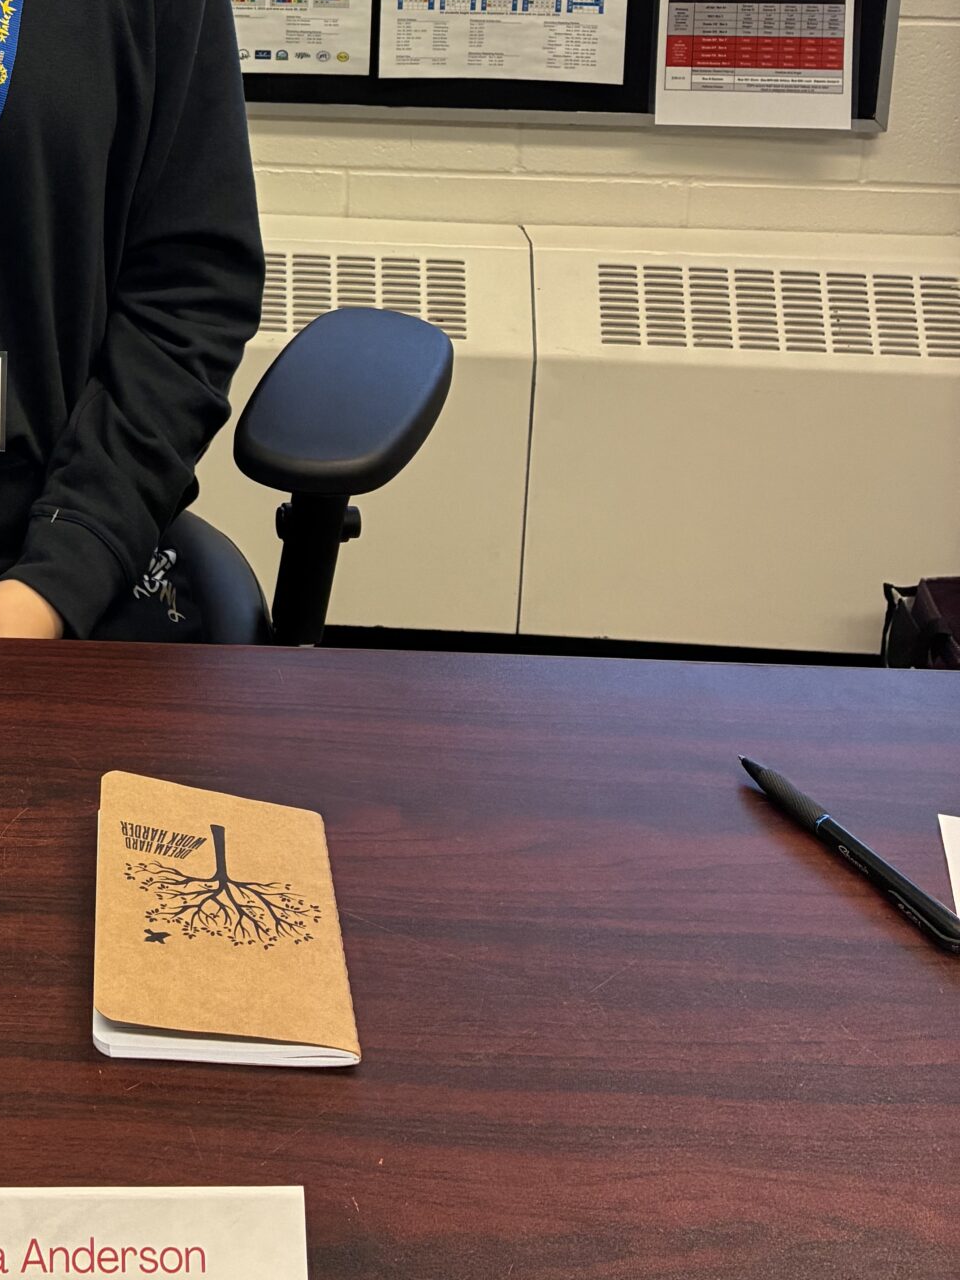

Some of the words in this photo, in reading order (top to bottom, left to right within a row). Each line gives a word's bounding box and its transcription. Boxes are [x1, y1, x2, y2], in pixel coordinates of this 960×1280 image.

[120, 821, 168, 843] HARDER
[166, 832, 207, 850] WORK
[125, 837, 153, 854] HARD
[154, 843, 192, 859] DREAM
[21, 1236, 207, 1274] Anderson
